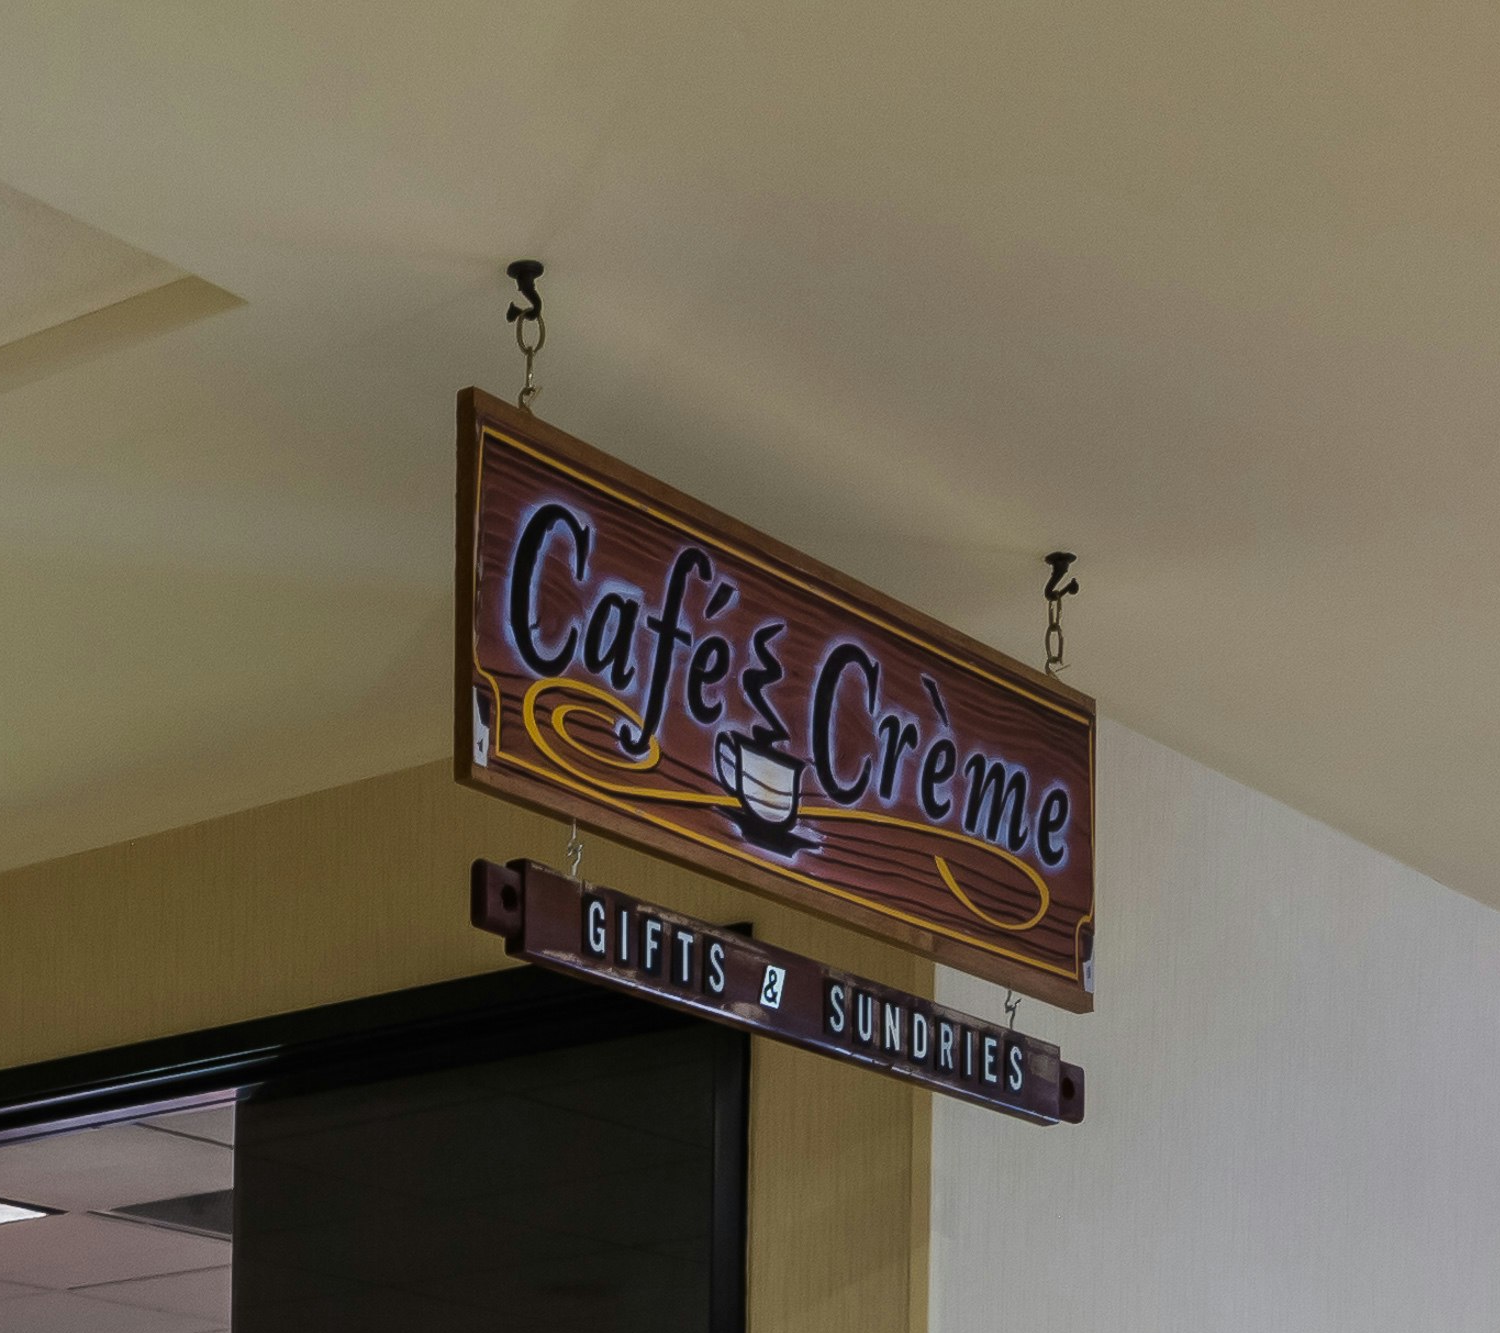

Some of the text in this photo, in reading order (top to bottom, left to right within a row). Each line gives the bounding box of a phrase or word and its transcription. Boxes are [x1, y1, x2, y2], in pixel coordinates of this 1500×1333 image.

[509, 503, 1070, 867] Café Crème
[588, 900, 1025, 1092] GIFTS & SUNDRIES
